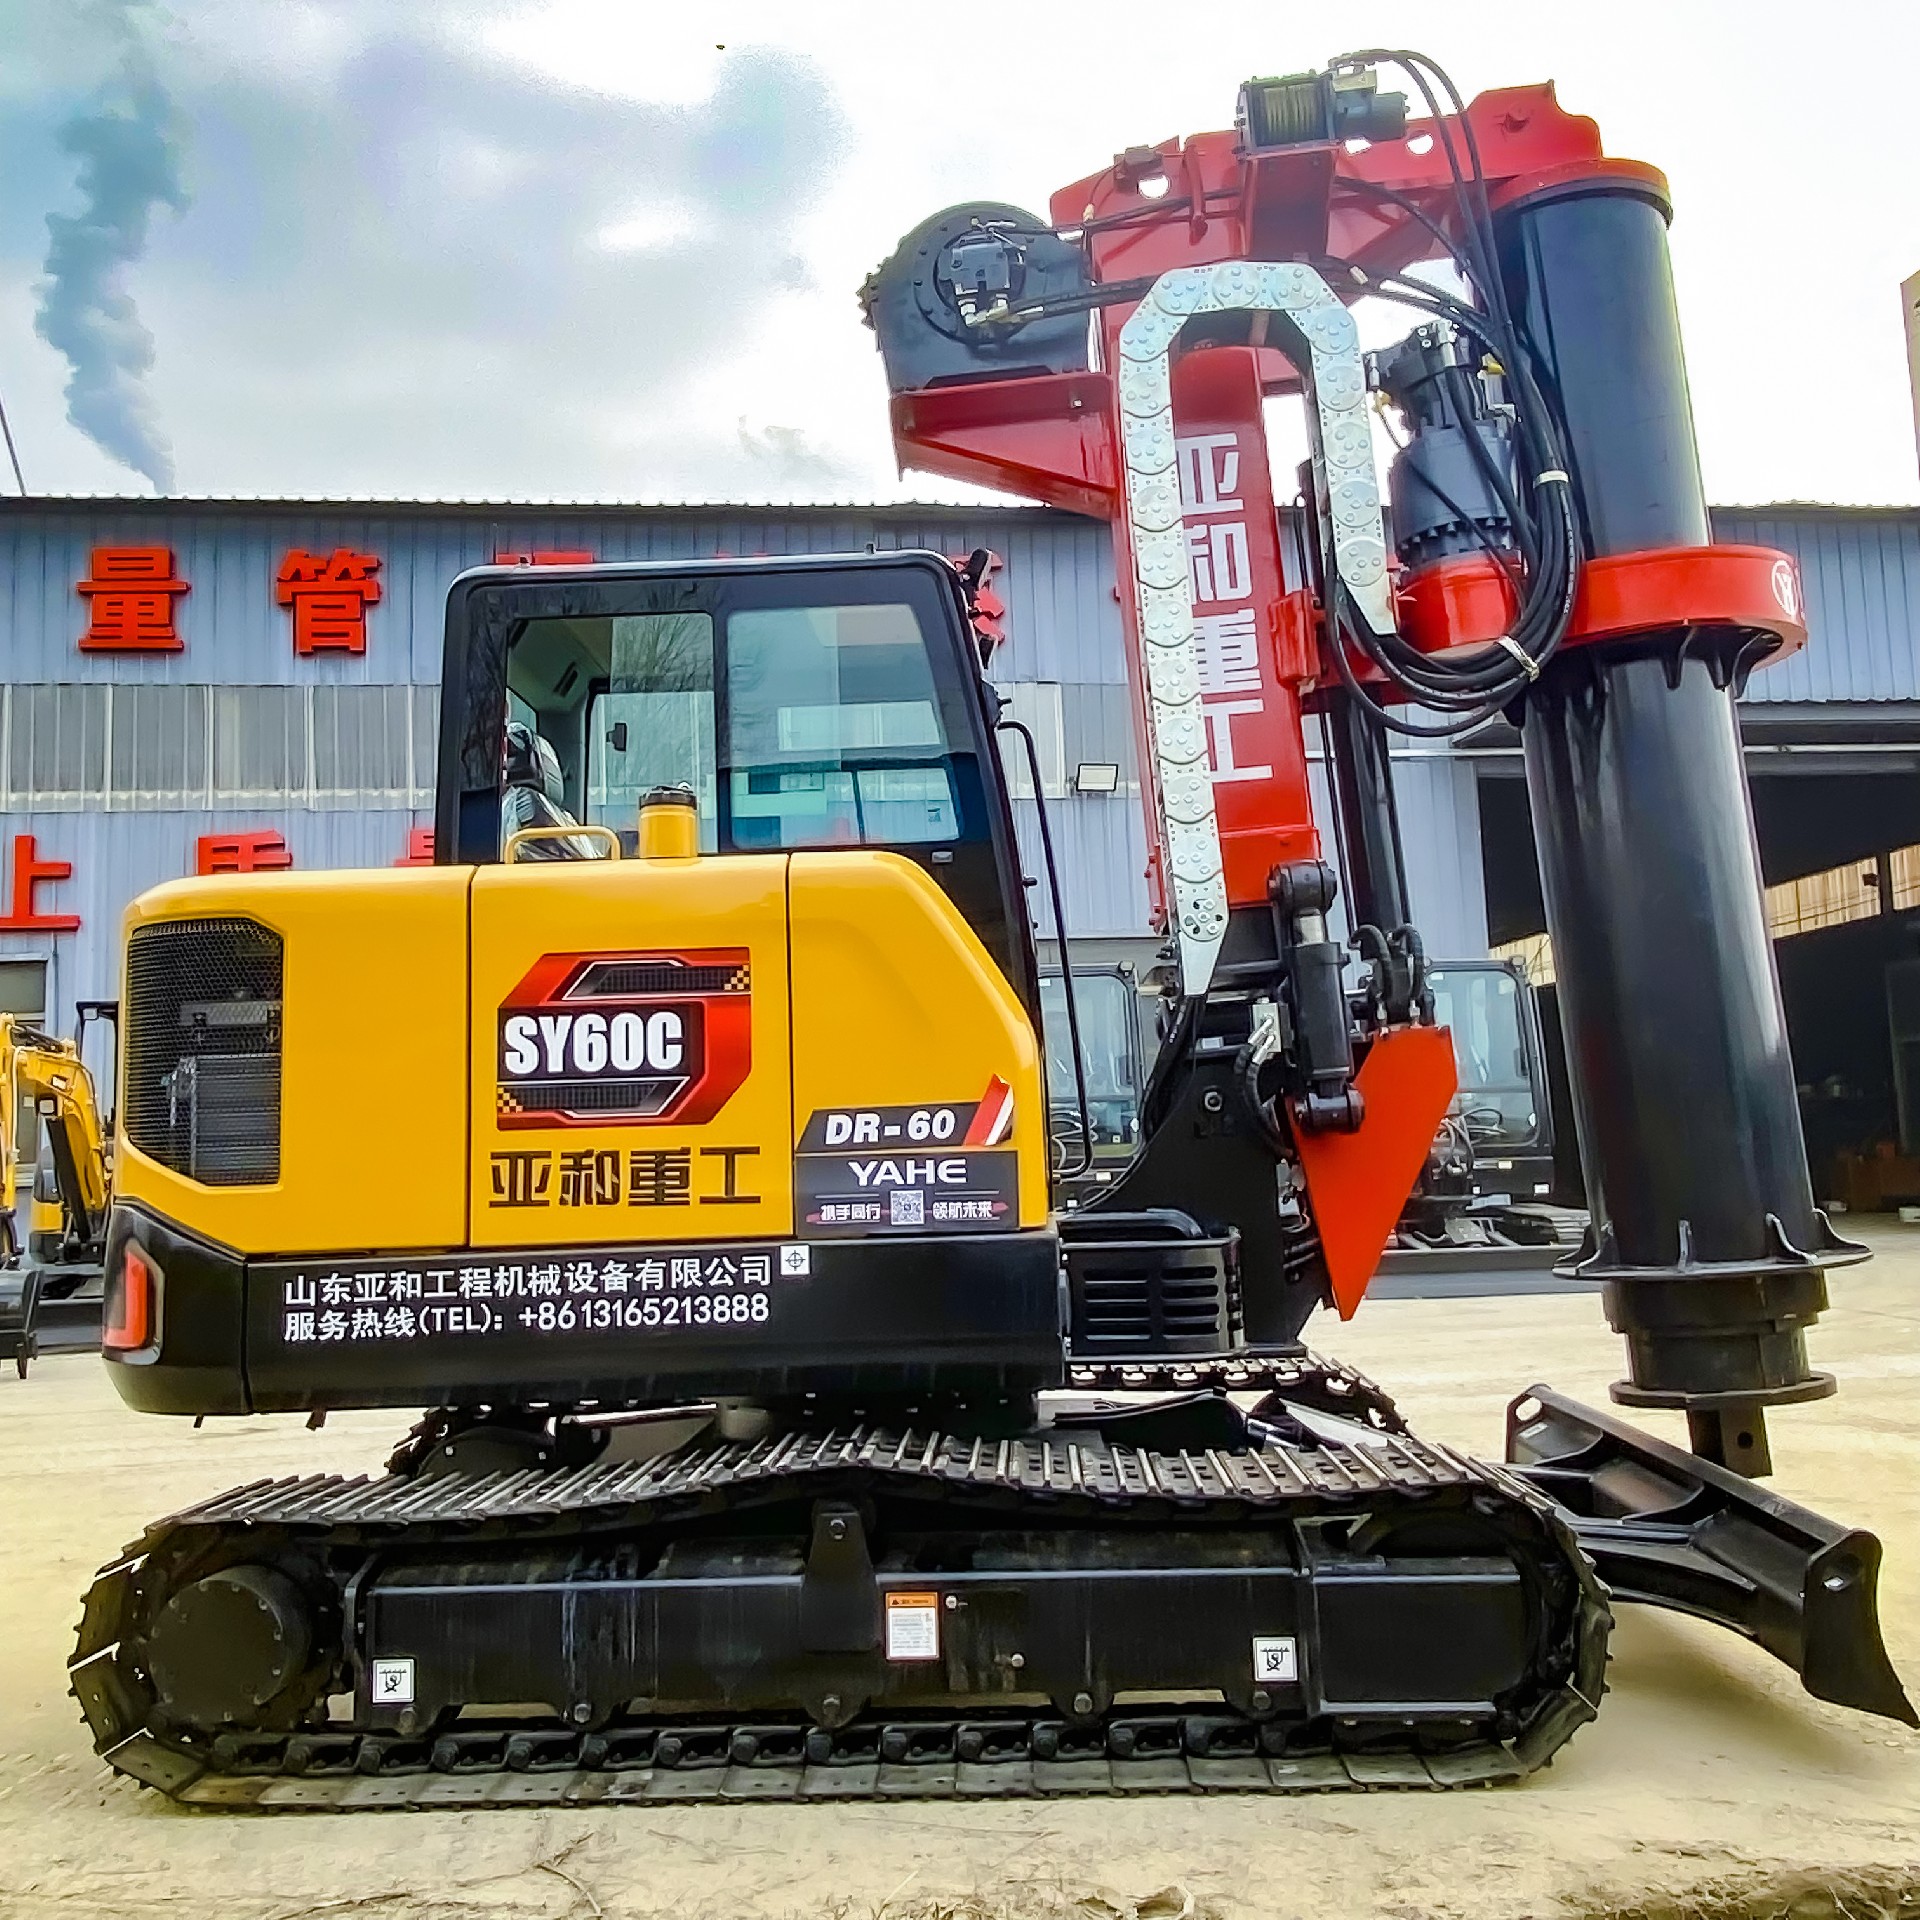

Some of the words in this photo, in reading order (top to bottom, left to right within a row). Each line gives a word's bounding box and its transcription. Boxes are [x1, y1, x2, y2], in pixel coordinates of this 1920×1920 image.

[503, 1010, 684, 1076] SY60C
[825, 1107, 957, 1146] DR-60
[488, 1146, 762, 1209] 亚和重工
[848, 1157, 968, 1188] YAHE
[932, 1200, 993, 1220] 领航未来
[284, 1254, 773, 1308] 山东亚和工程机械设备有限公司
